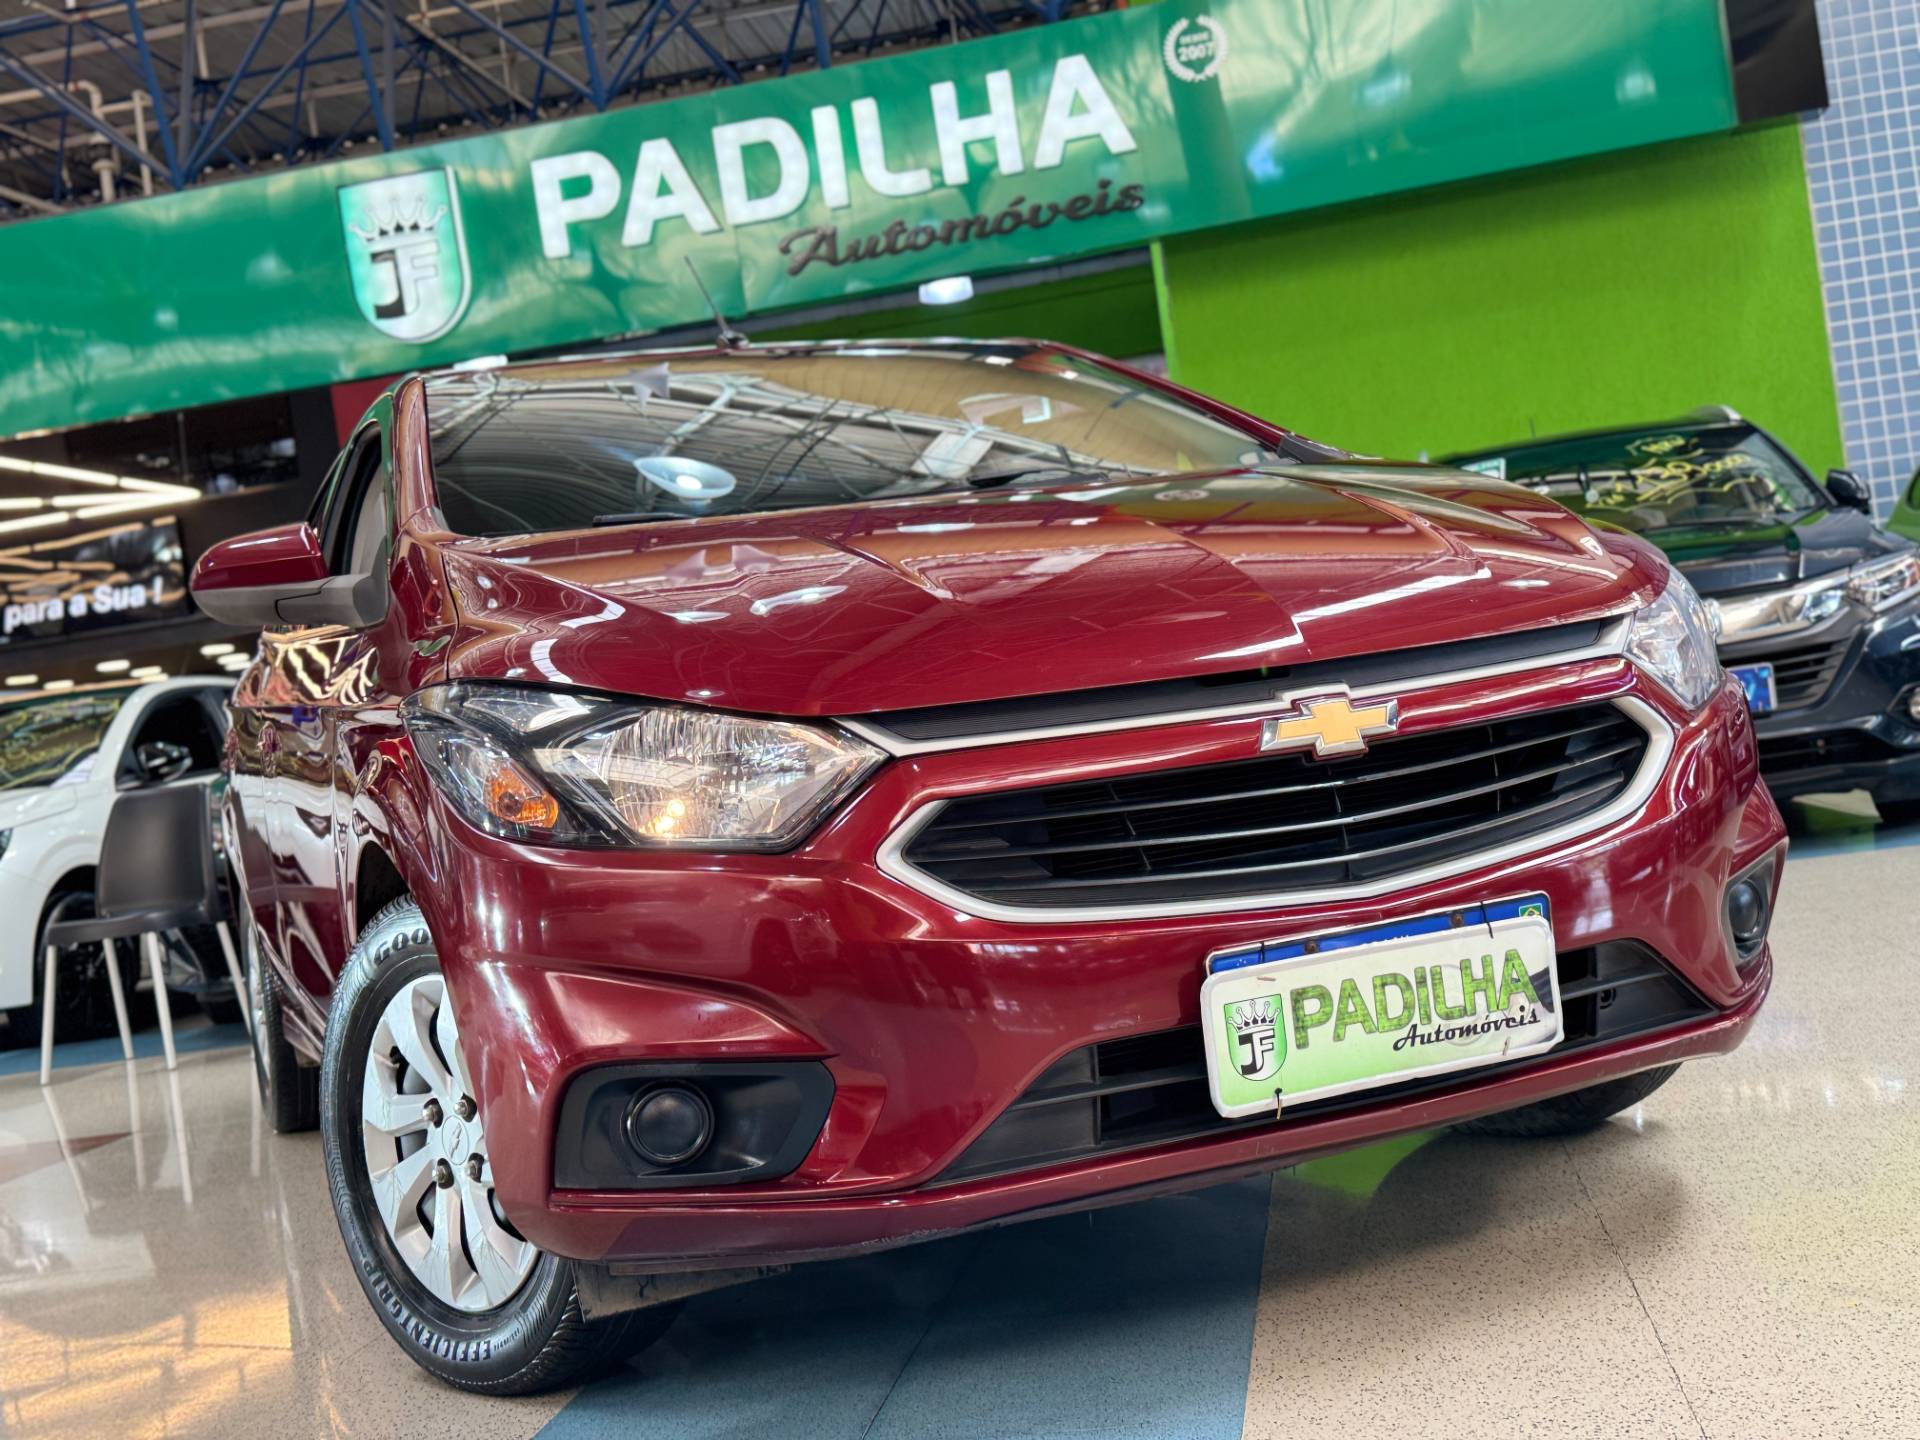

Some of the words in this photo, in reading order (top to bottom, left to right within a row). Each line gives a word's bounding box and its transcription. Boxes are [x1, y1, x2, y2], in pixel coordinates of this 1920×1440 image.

[530, 54, 1138, 258] PADILHA
[778, 178, 1144, 276] Automóveis
[3, 600, 64, 634] para
[69, 594, 87, 617] a
[92, 584, 146, 613] Sua
[1290, 949, 1540, 1050] PADILHA
[1392, 1004, 1541, 1051] Automóveis
